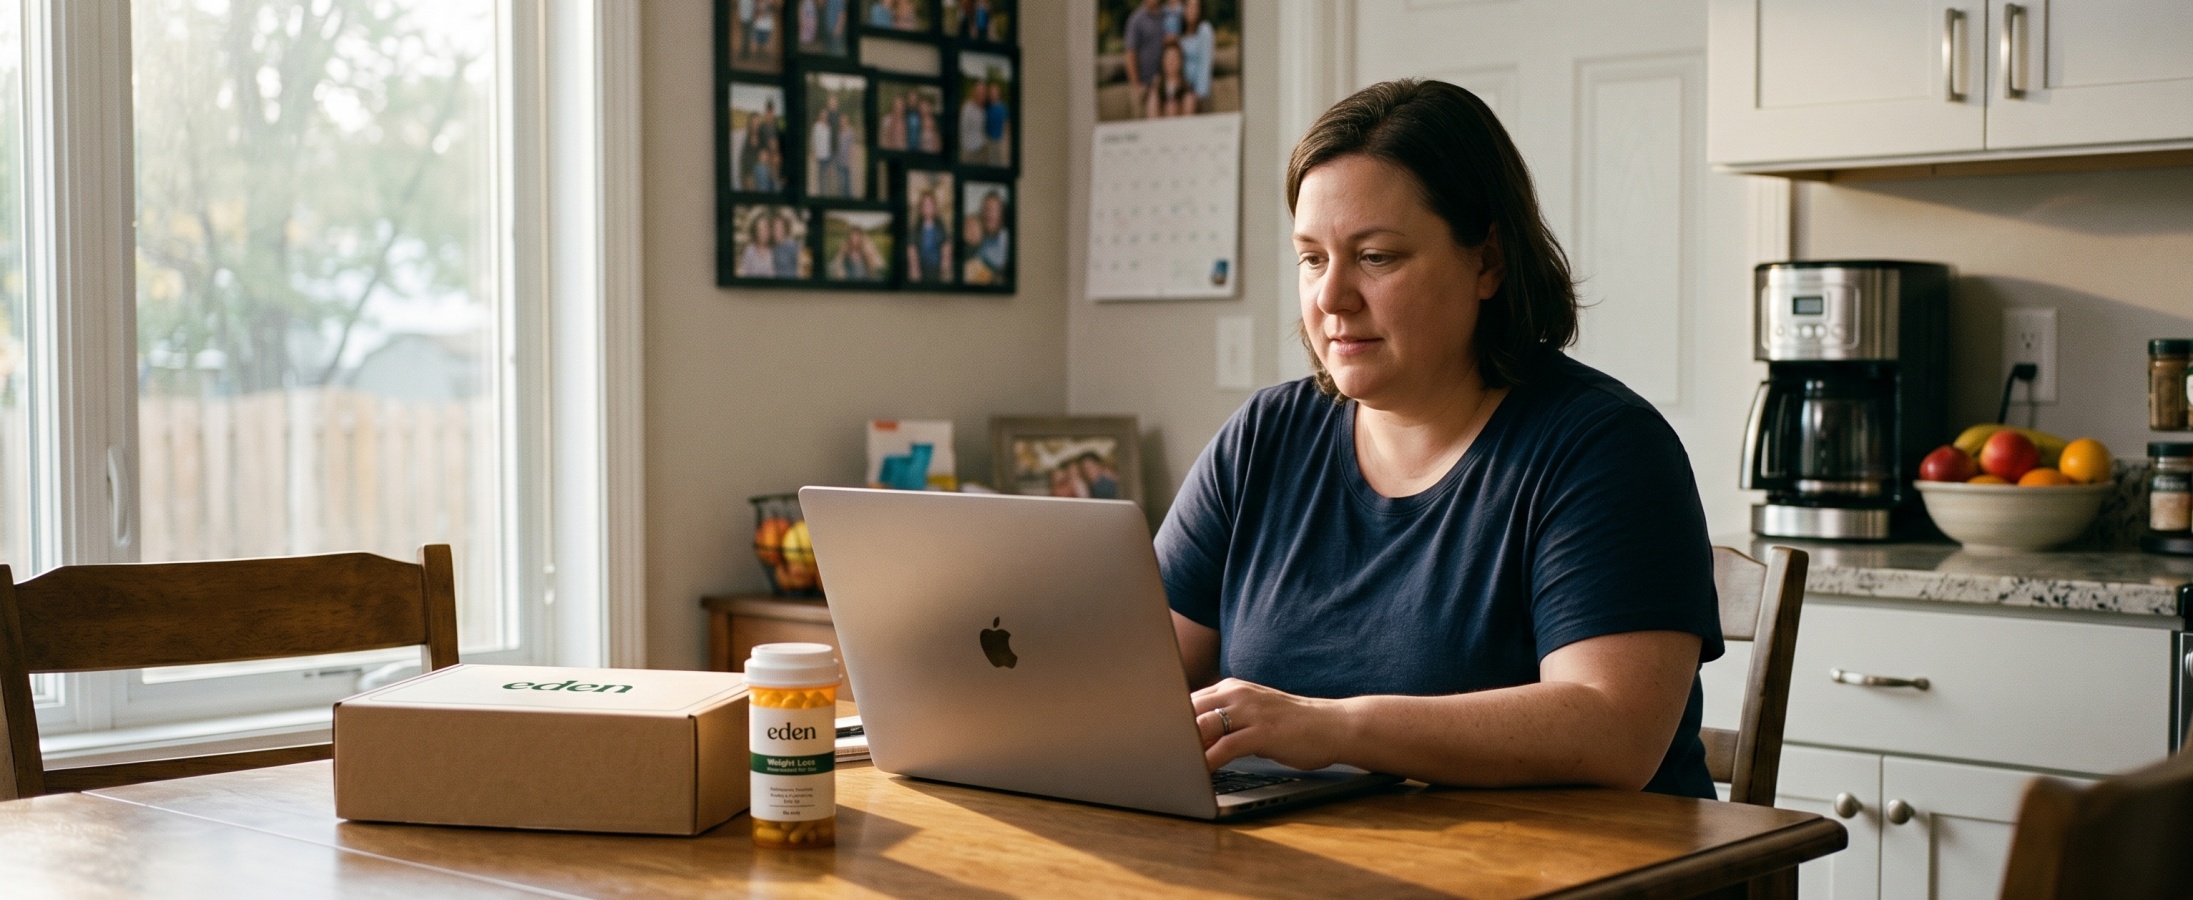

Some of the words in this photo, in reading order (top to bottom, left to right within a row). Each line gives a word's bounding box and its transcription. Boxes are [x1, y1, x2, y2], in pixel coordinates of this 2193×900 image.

[502, 680, 633, 693] eden
[767, 722, 816, 740] eden
[767, 758, 794, 767] Weight
